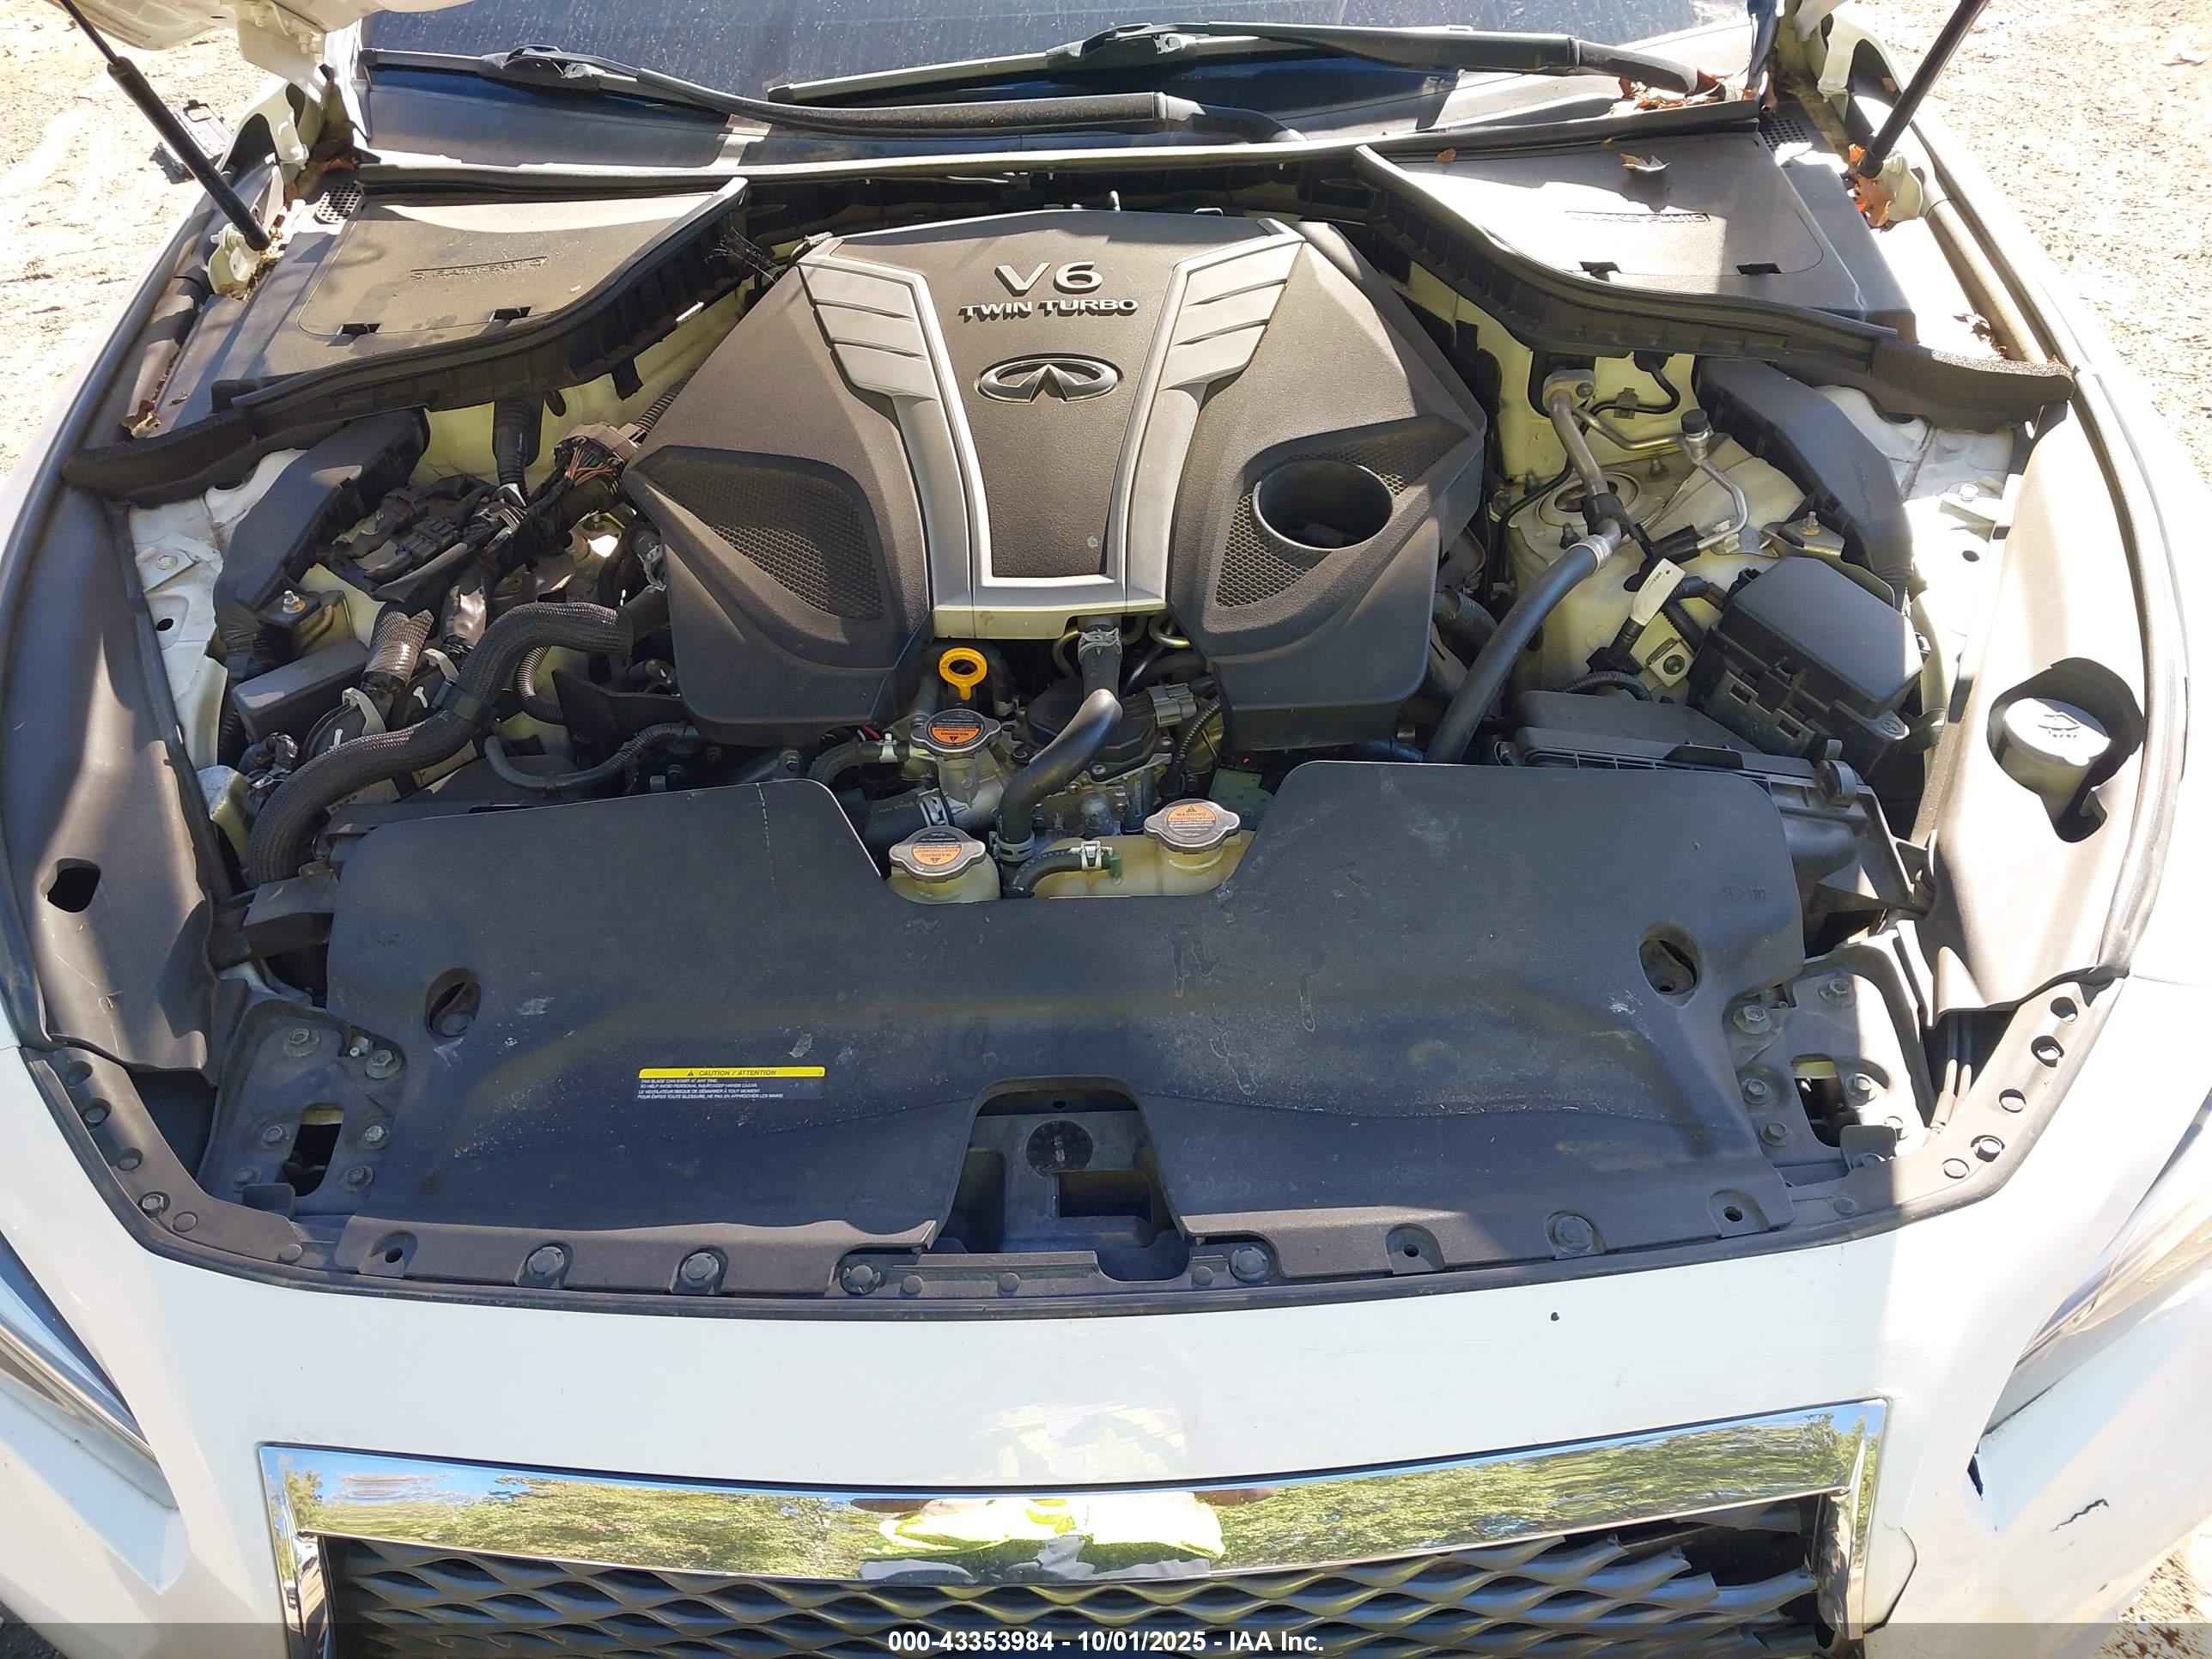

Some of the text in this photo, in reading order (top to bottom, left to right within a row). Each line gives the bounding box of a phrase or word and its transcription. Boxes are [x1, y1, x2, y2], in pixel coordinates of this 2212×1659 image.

[1648, 214, 1707, 223] FLUID
[994, 261, 1103, 296] V6
[958, 299, 1139, 322] TWIN TURBO
